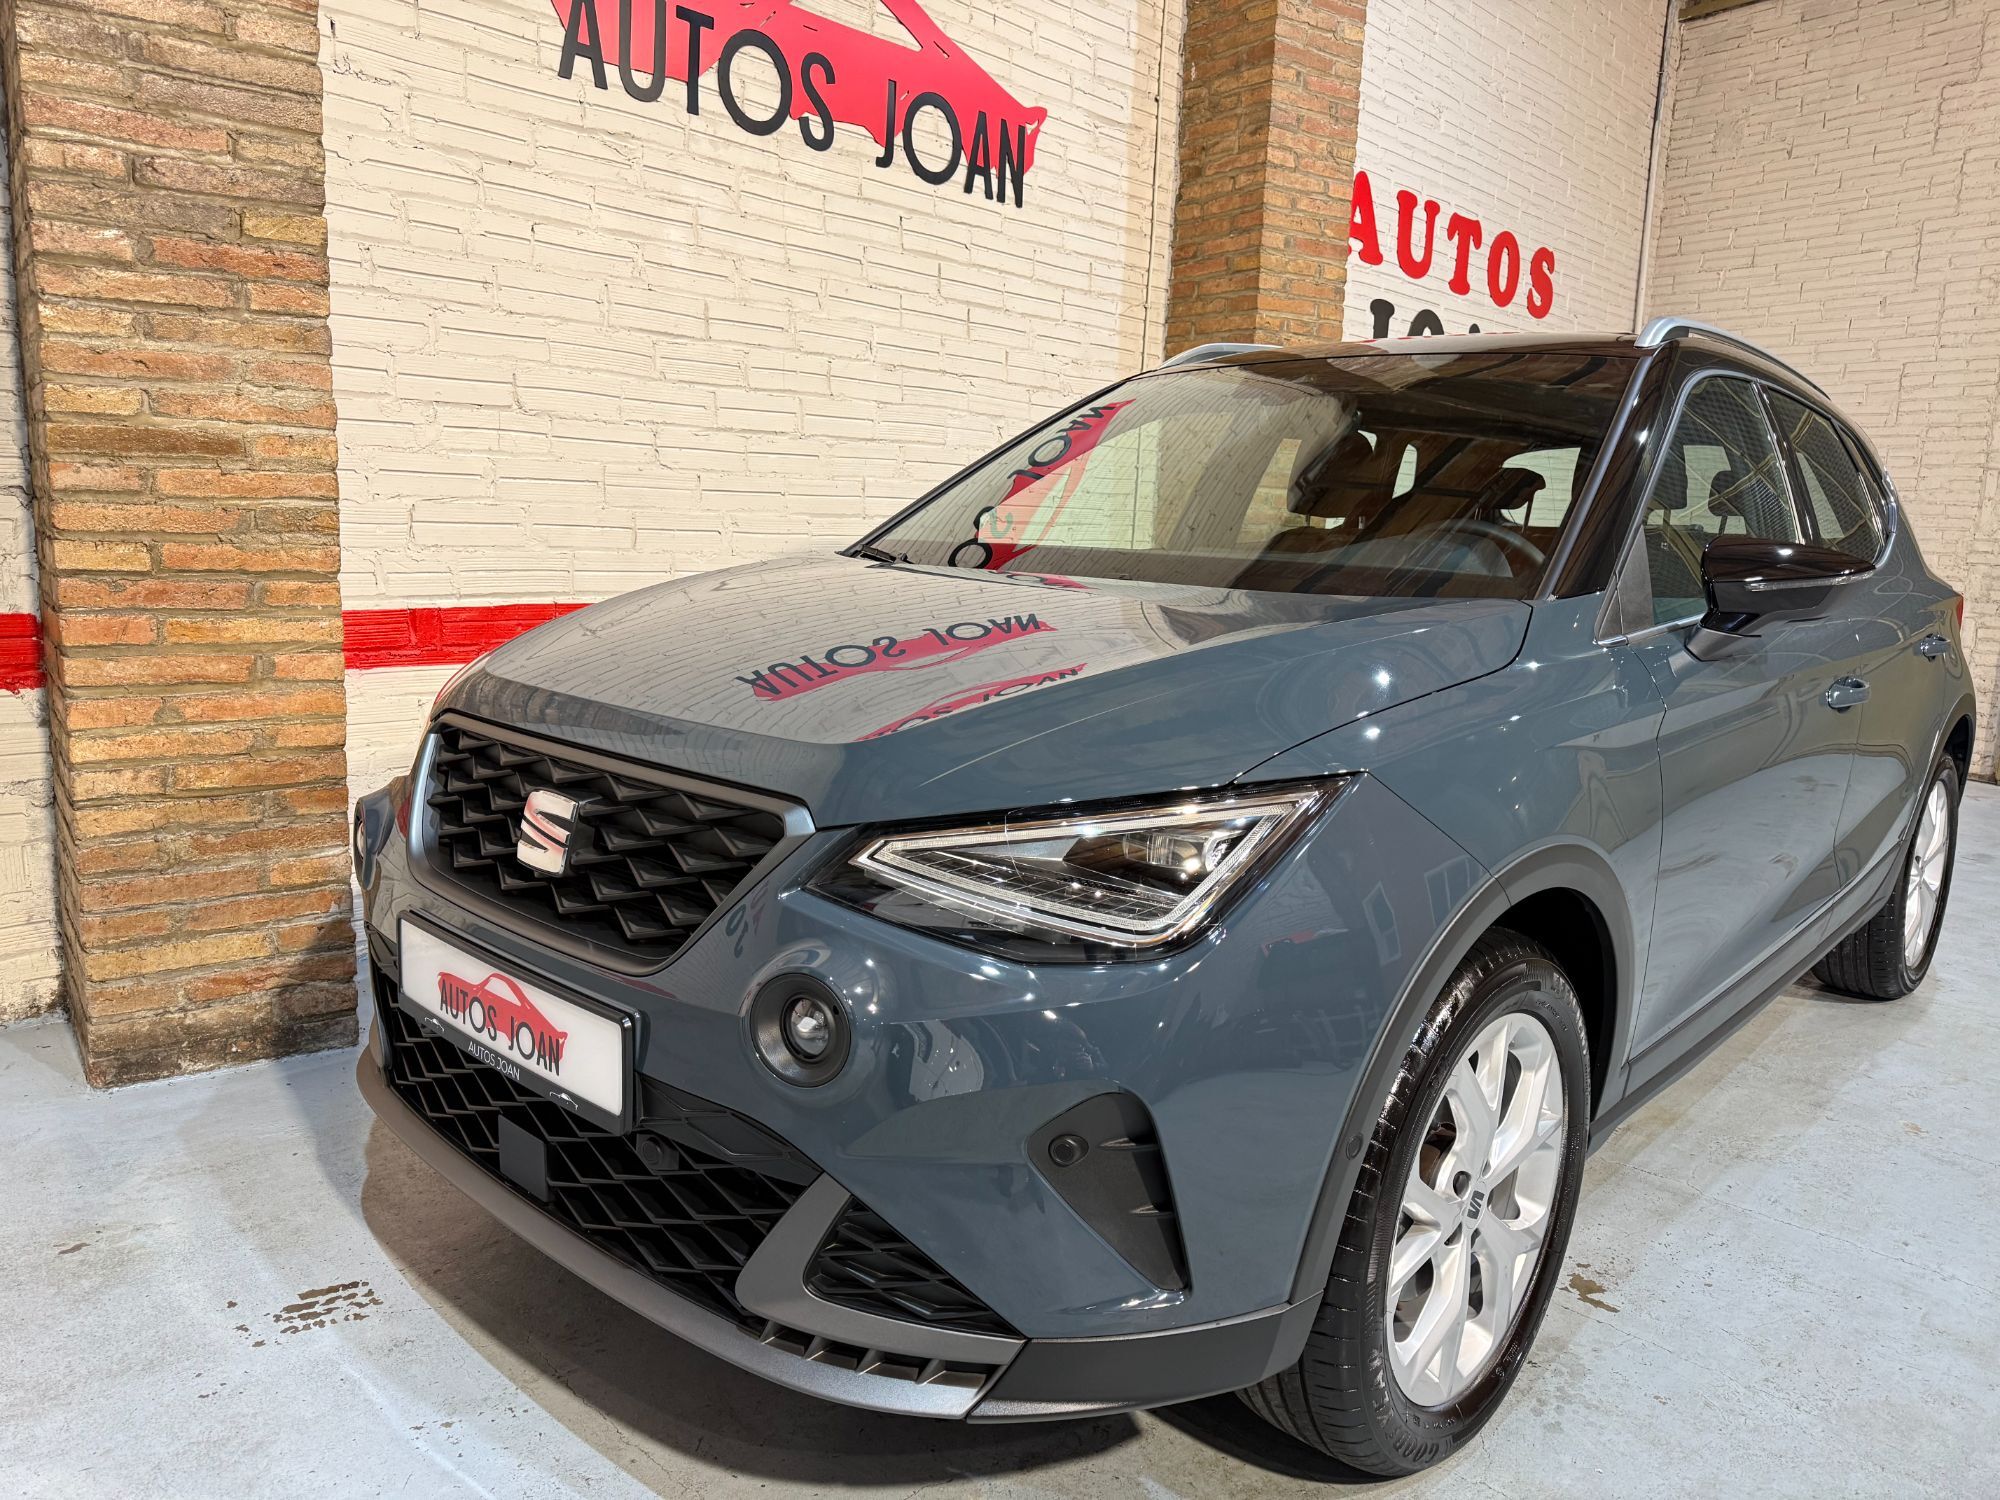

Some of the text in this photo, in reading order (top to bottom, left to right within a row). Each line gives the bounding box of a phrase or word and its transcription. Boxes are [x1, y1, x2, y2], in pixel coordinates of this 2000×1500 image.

[557, 0, 1026, 209] AUTOS JOAN
[1348, 170, 1556, 320] AUTOS
[440, 978, 561, 1077] AUTOS JOAN
[467, 1040, 520, 1081] AUTOS JOAN
